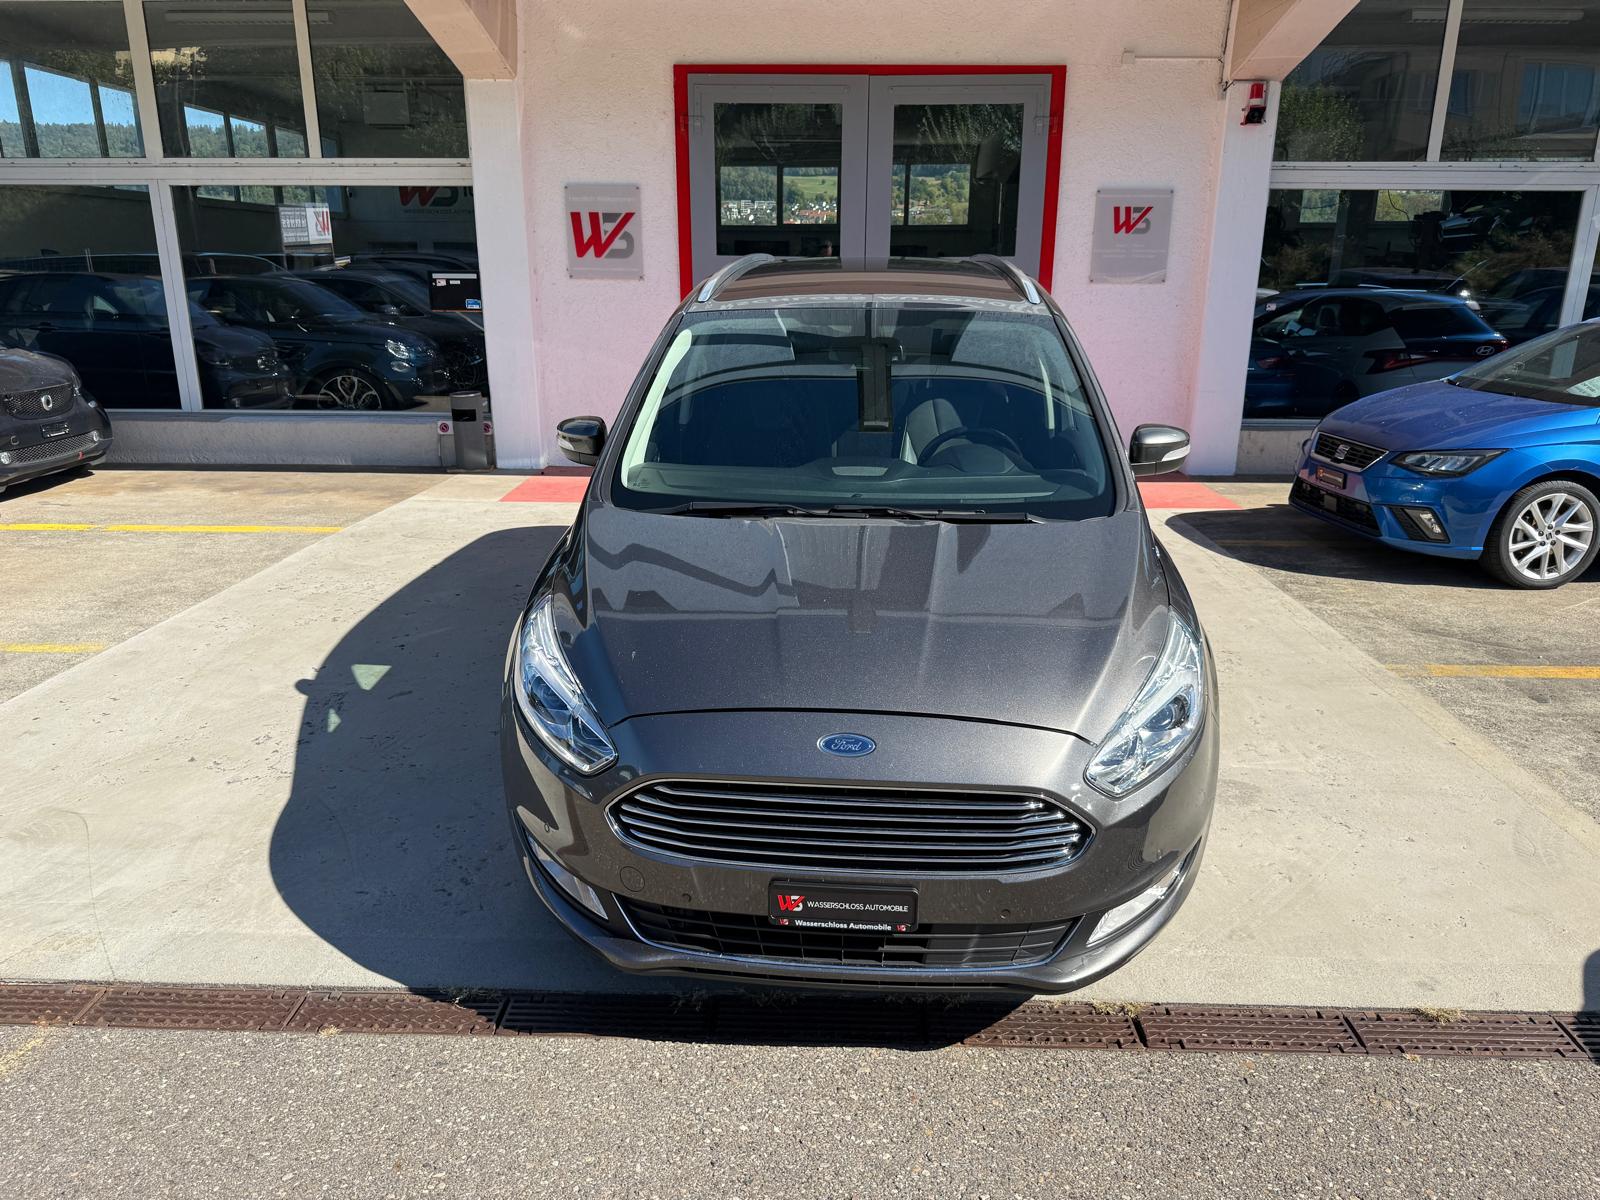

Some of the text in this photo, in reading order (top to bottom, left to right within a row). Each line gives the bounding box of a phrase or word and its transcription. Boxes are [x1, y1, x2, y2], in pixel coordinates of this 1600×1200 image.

[831, 738, 863, 751] Ford
[807, 900, 909, 913] WASSERSCHLOSS AUTOMOBILE
[795, 919, 892, 931] Wasserschloss Automobile
